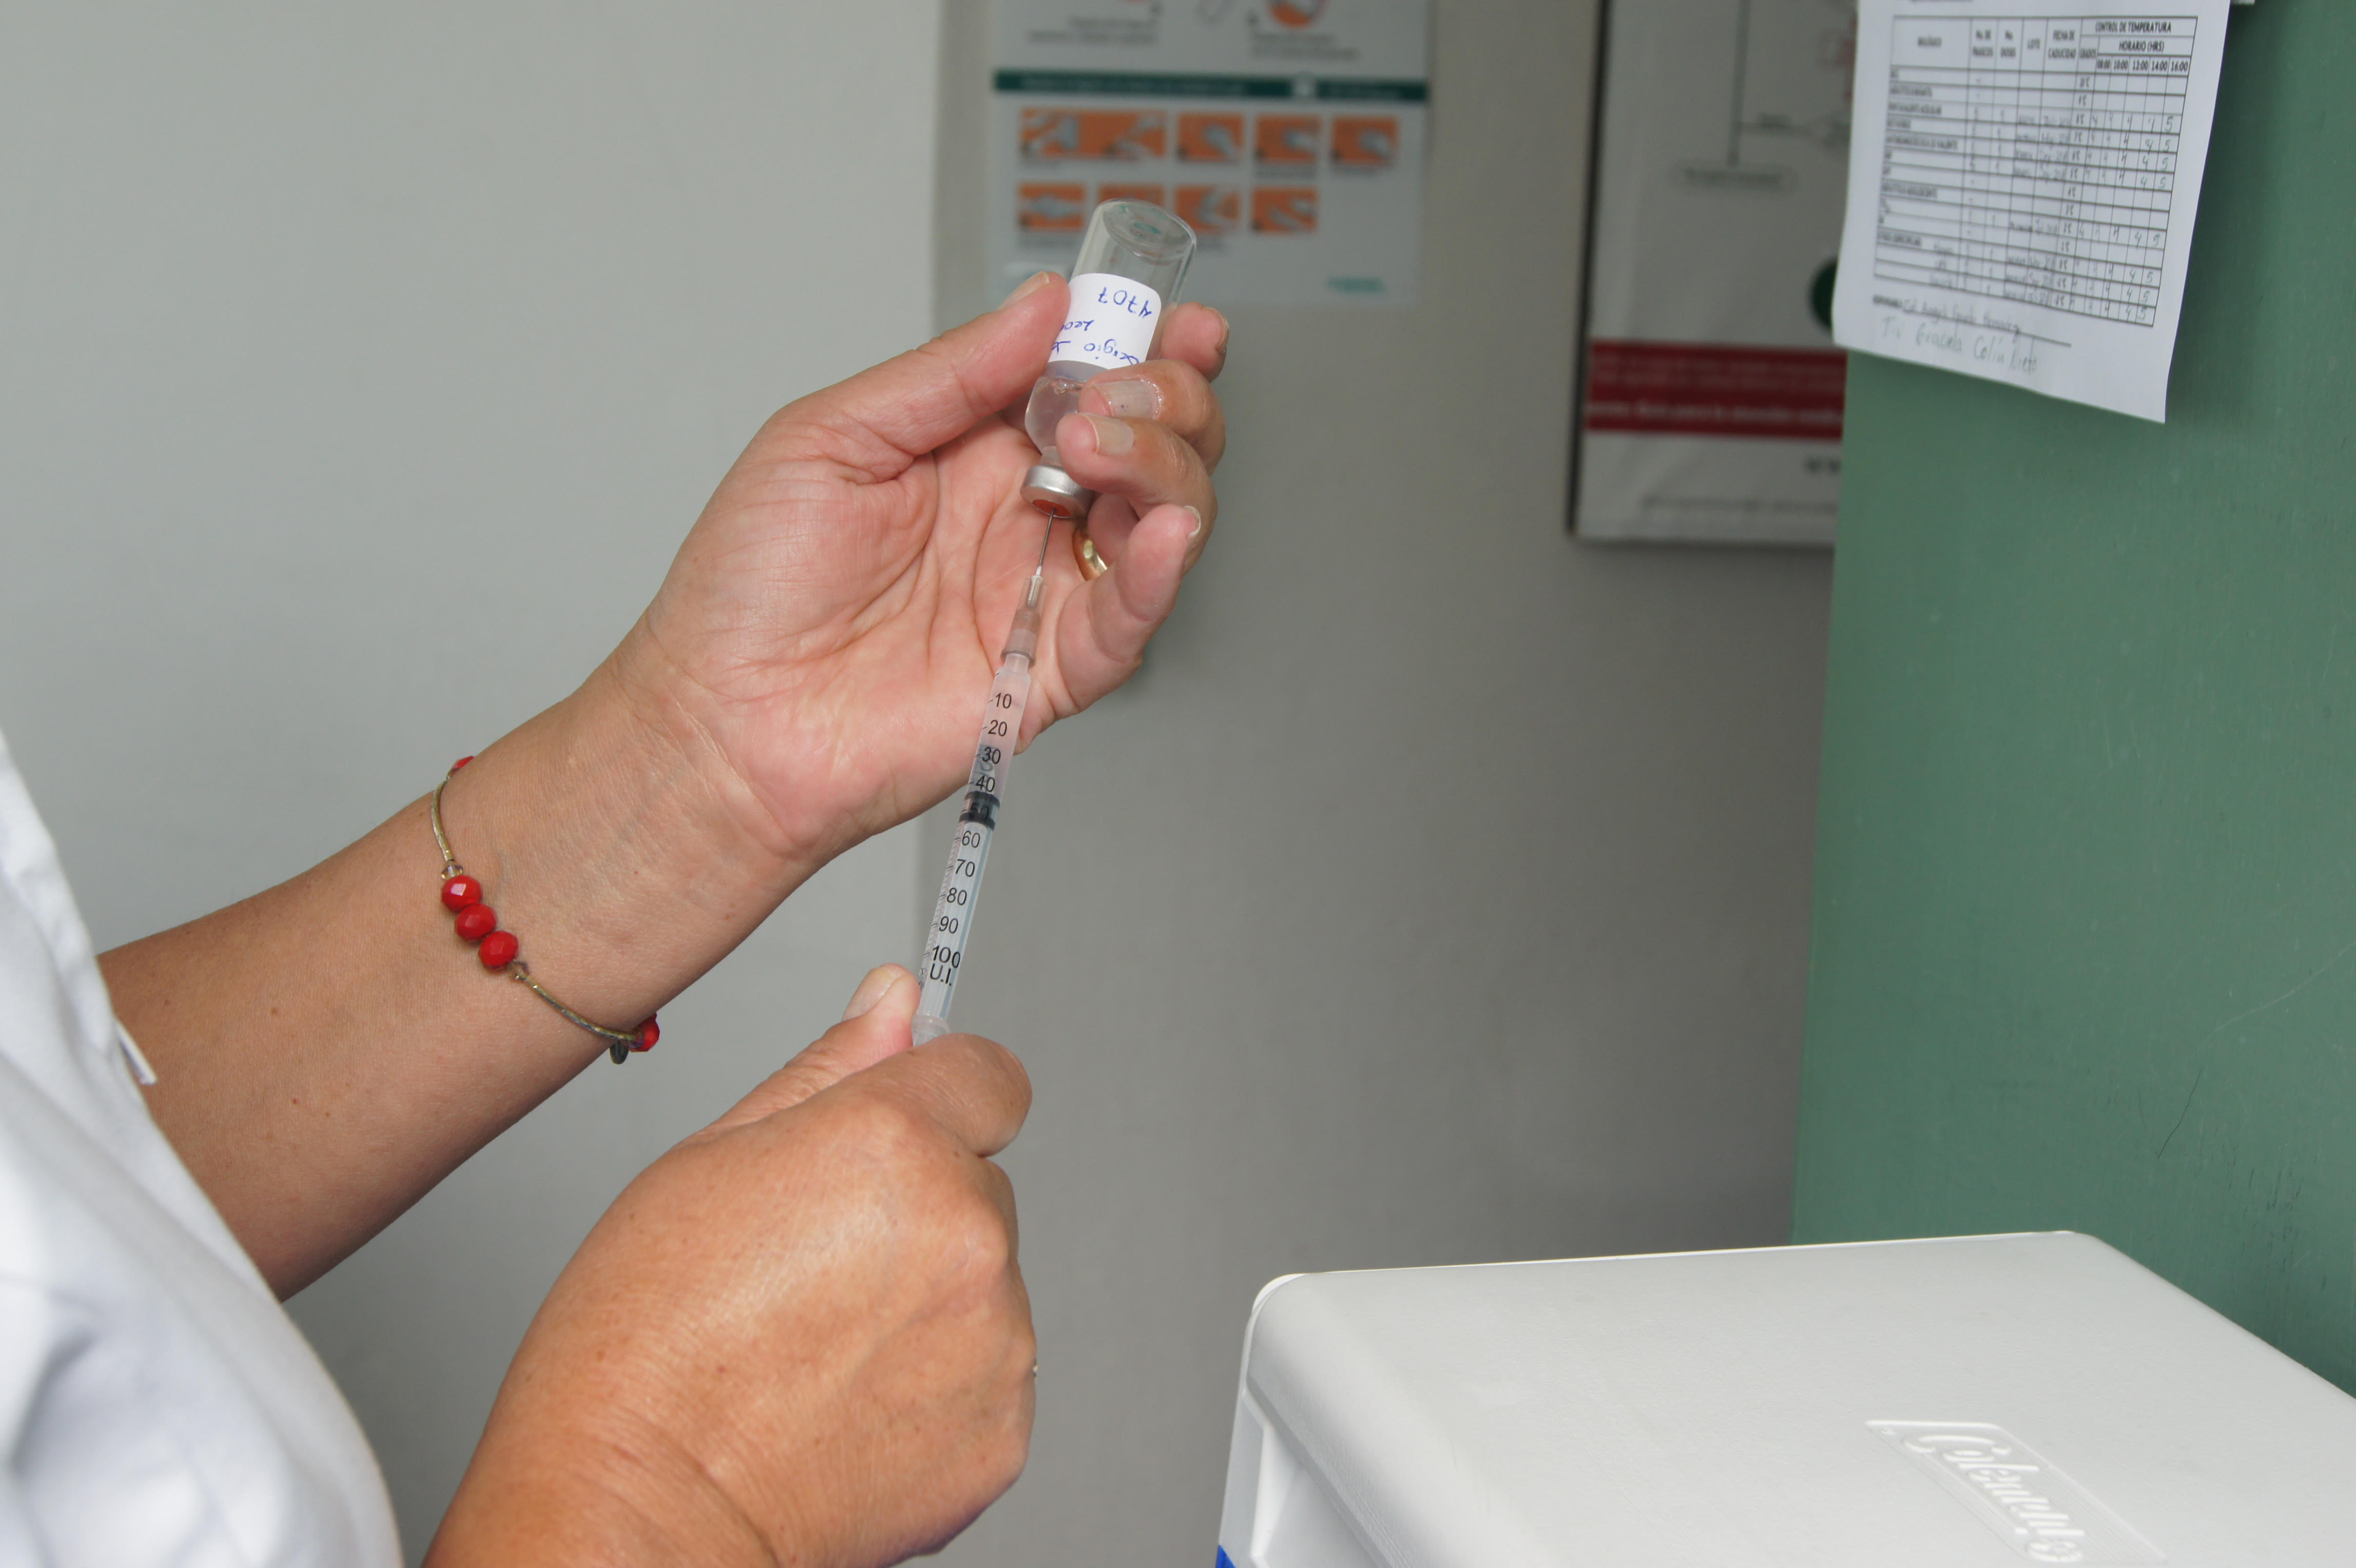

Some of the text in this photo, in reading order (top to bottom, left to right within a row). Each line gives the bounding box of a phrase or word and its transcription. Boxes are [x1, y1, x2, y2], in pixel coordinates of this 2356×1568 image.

[2095, 21, 2172, 33] CONTROL DE TEMPERATURA
[2118, 41, 2165, 53] HORARIO (HRS)
[2097, 59, 2188, 72] 08:00 10:00 12:00 14:00 16:00
[2165, 115, 2174, 132] 5
[2163, 139, 2171, 152] 5
[2142, 154, 2149, 171] 4
[2160, 156, 2169, 171] 5
[2140, 176, 2147, 192] 4
[2158, 177, 2167, 189] 5
[2134, 231, 2142, 249] 4
[2152, 233, 2161, 246] 5
[2129, 268, 2136, 284] 4
[2145, 271, 2154, 283] 5
[1098, 286, 1152, 318] 4707
[2127, 287, 2133, 303] 4
[2143, 290, 2151, 302] 5
[2126, 305, 2131, 322] 4
[2138, 306, 2148, 320] 5
[994, 693, 1012, 710] 10
[987, 719, 1008, 737] 20
[982, 747, 1000, 765] 30
[976, 774, 995, 793] 40
[969, 802, 989, 820] 50
[961, 831, 981, 849] 60
[954, 858, 976, 878] 70
[946, 887, 968, 906] 80
[938, 916, 959, 934] 90
[932, 945, 961, 969] 100
[929, 963, 952, 986] U.I.
[1900, 1435, 2086, 1538] Coleman
